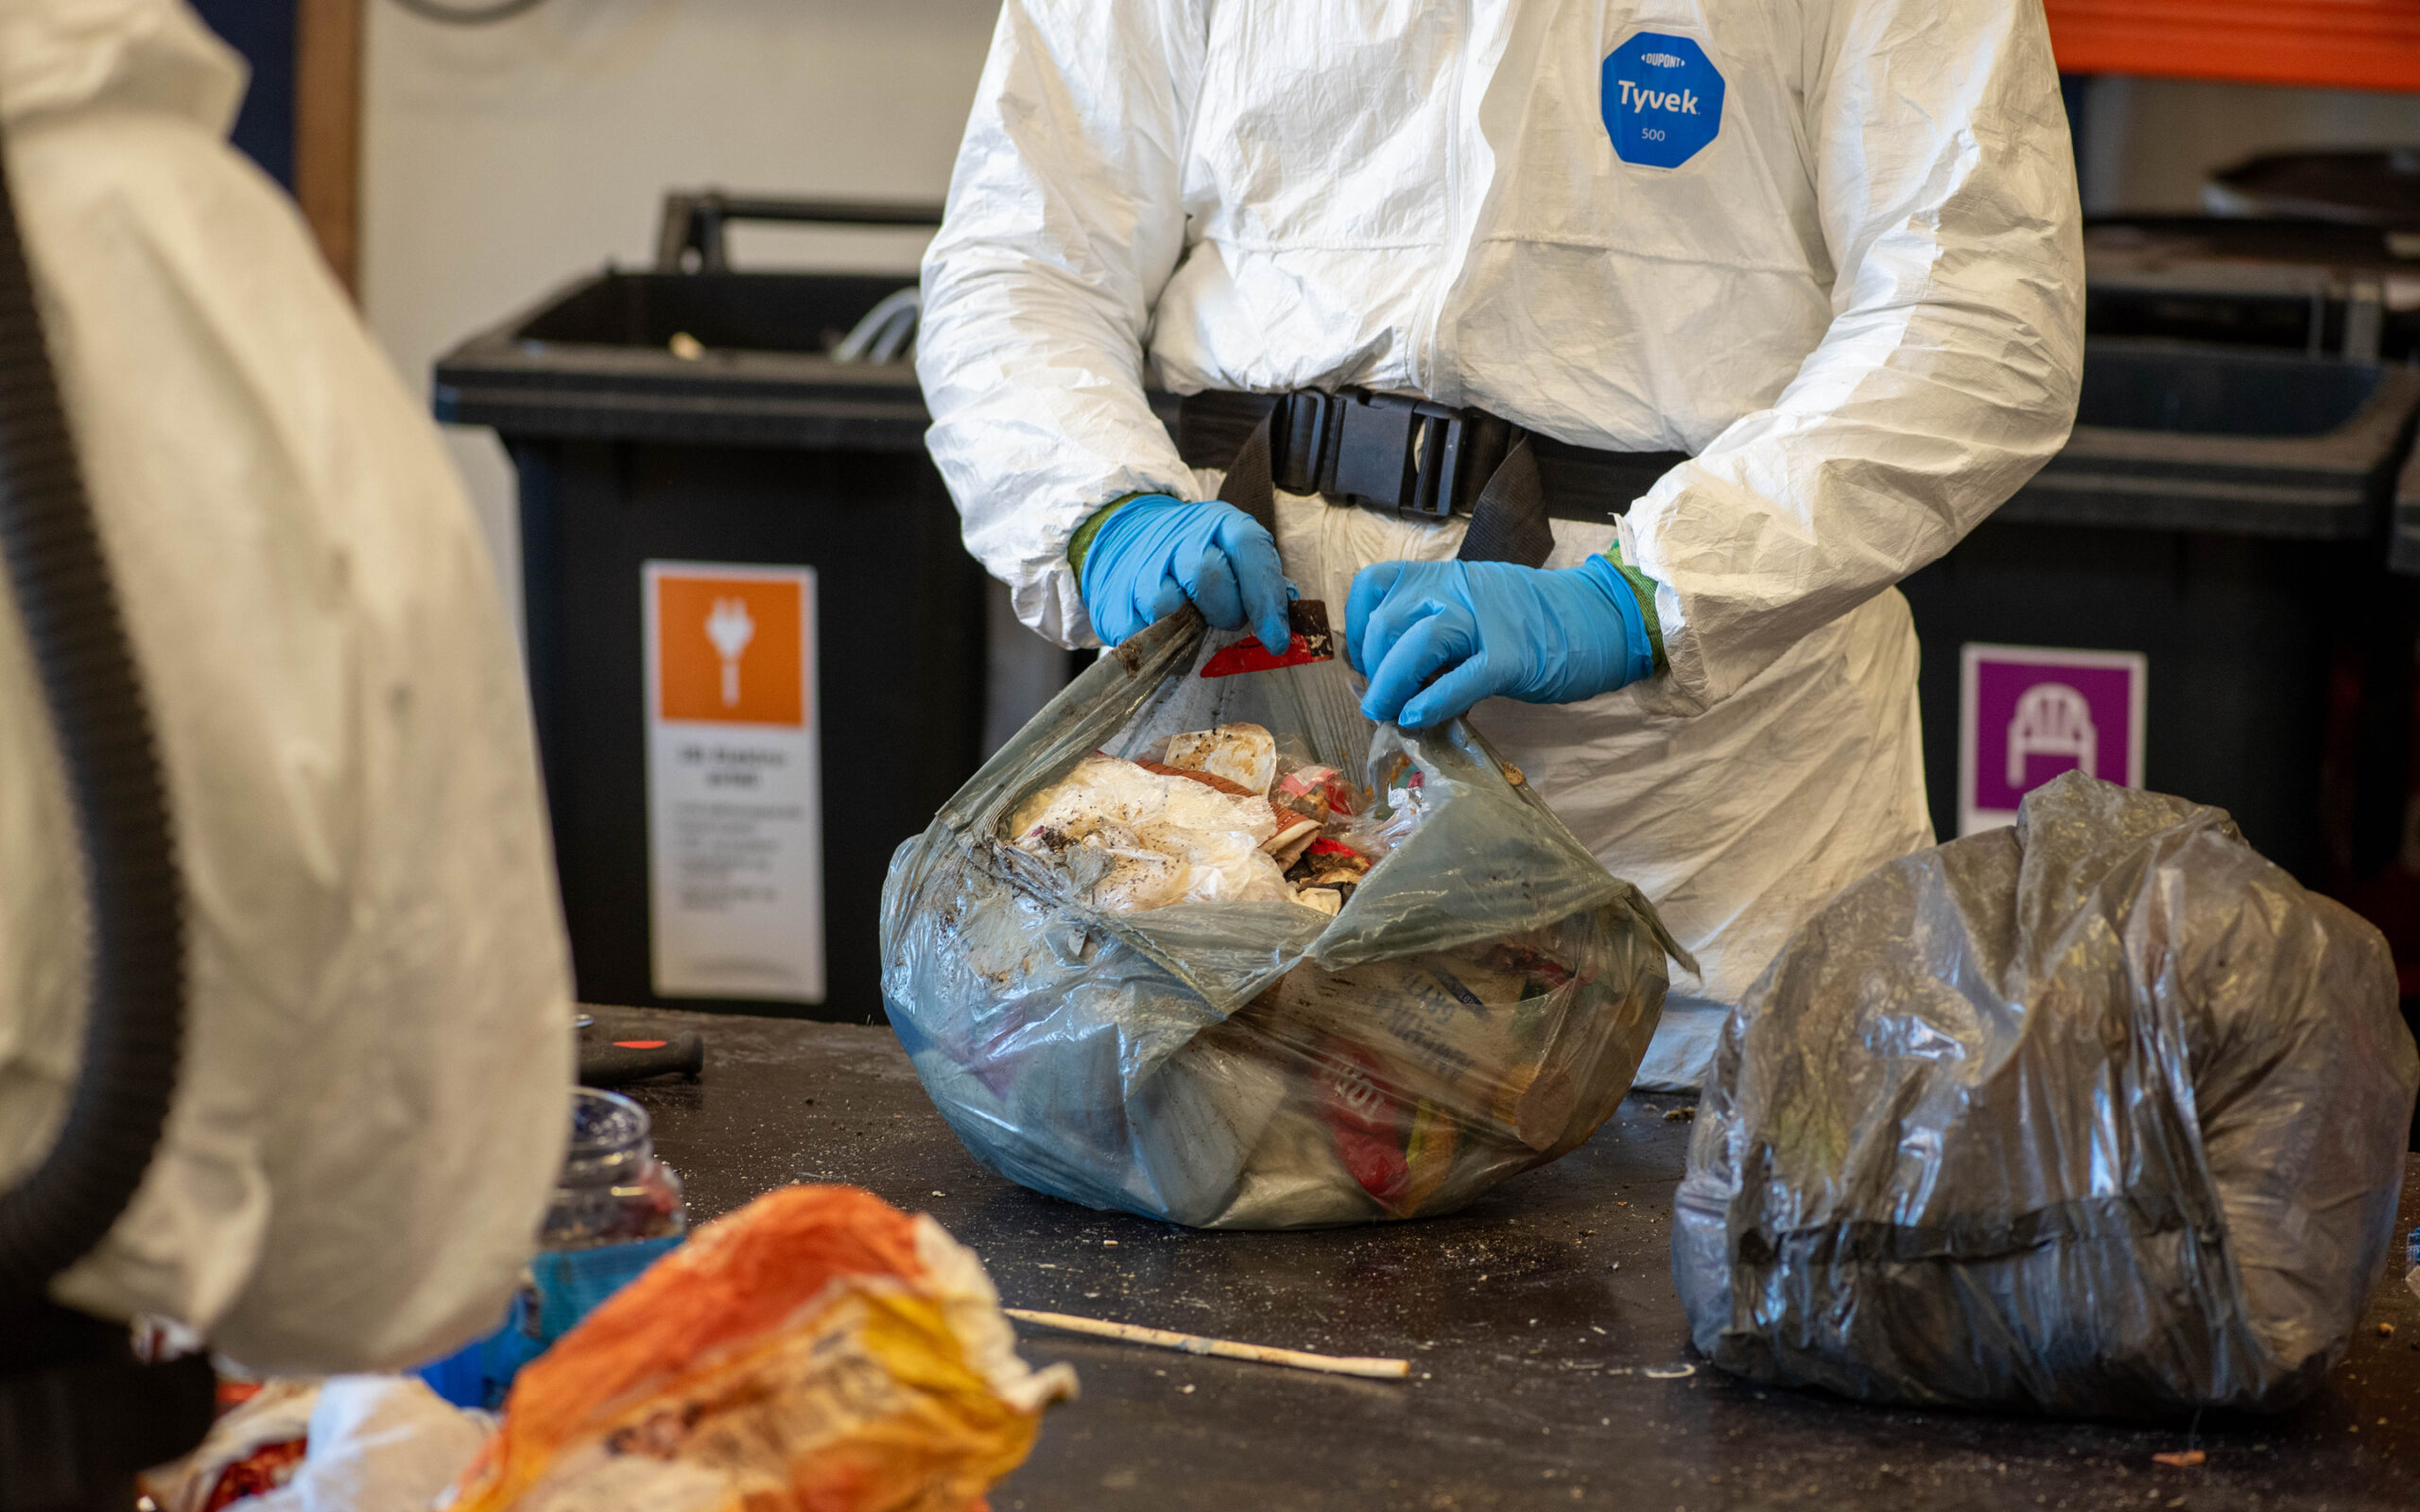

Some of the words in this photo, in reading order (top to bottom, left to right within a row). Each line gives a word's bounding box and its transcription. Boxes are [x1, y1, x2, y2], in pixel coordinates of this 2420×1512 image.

[1646, 53, 1681, 68] DUPONT
[1618, 79, 1699, 114] Tyvek
[1641, 128, 1666, 142] 500
